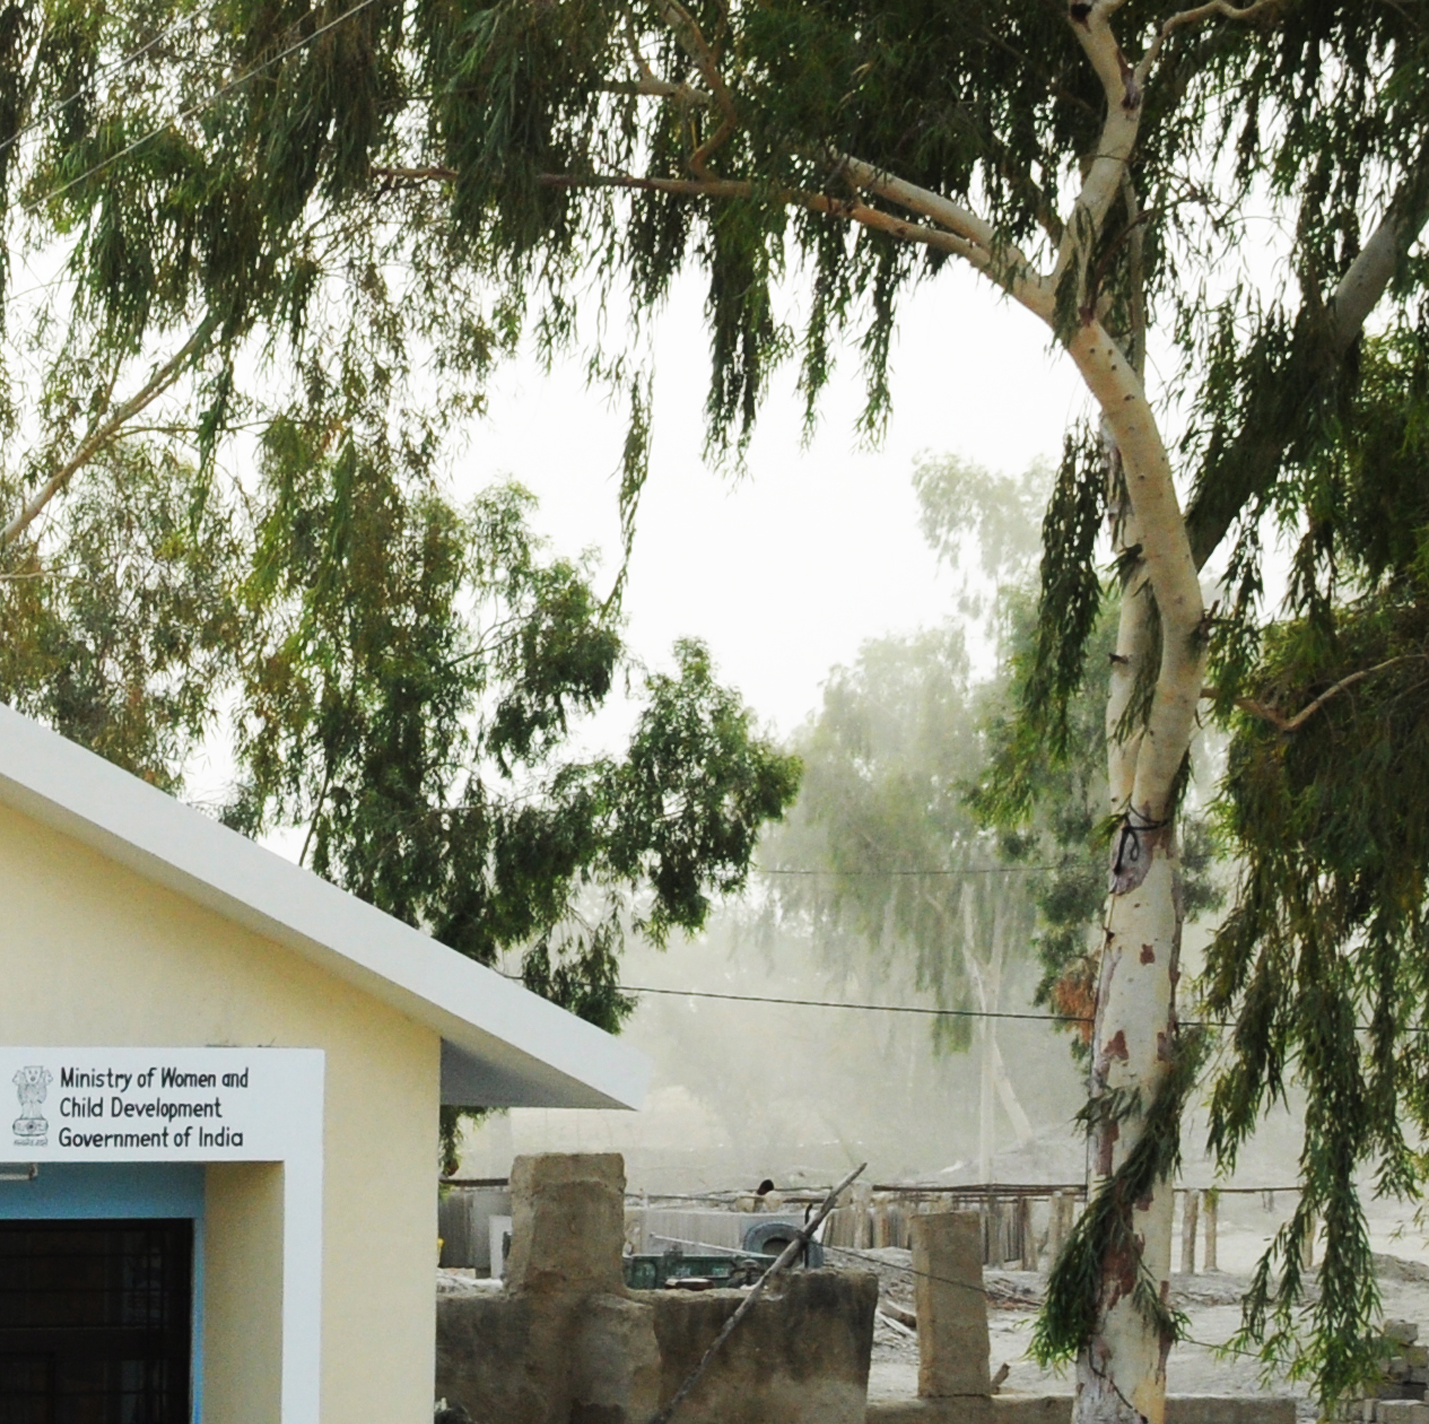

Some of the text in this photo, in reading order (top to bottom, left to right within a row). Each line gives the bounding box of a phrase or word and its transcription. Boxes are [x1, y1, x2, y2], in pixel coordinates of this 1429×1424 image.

[60, 1067, 249, 1093] Ministry of Women and
[59, 1096, 223, 1123] Child Development
[58, 1126, 169, 1148] Government
[173, 1126, 193, 1148] of
[199, 1126, 244, 1147] India
